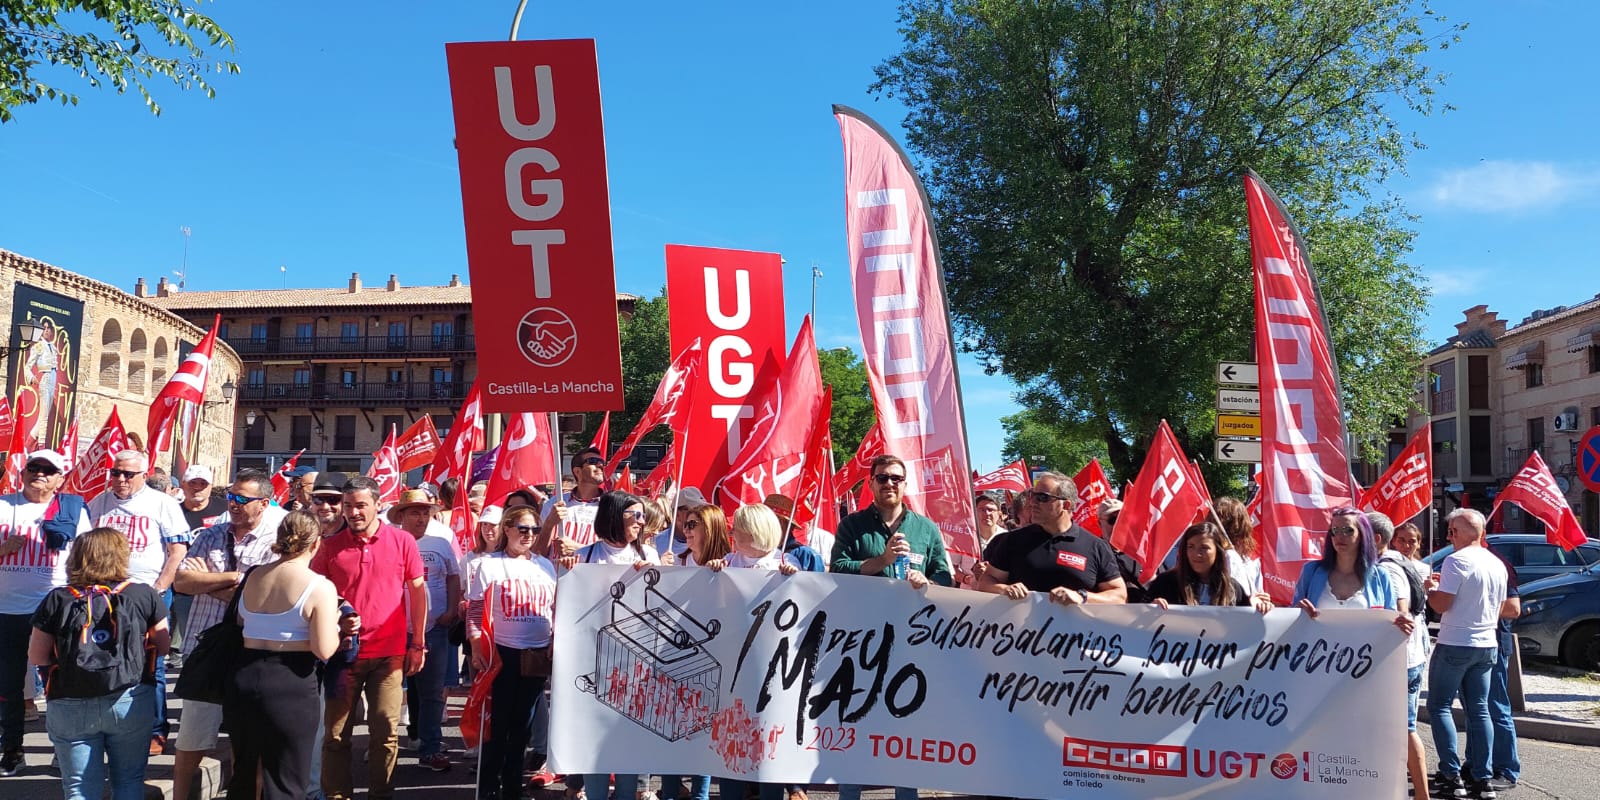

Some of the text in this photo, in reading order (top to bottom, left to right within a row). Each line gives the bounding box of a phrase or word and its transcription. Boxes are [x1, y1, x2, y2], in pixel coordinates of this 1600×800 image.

[494, 65, 566, 299] UGT
[704, 267, 754, 465] UGT
[488, 381, 614, 395] Castilla-La Mancha
[1222, 421, 1254, 429] juzgados
[826, 630, 857, 657] DE
[1245, 638, 1373, 681] precios
[756, 611, 927, 745] MAYO
[979, 665, 1289, 727] repartir beneficios
[806, 726, 976, 765] 2023 TOLEDO
[1067, 742, 1150, 769] CCOO
[1317, 753, 1360, 765] Castilla-
[1063, 770, 1146, 784] comisiones obreras
[1194, 749, 1265, 779] UGT
[1318, 765, 1379, 778] La Mancha
[1063, 778, 1103, 789] de Toledo
[1319, 775, 1348, 785] Toledo
